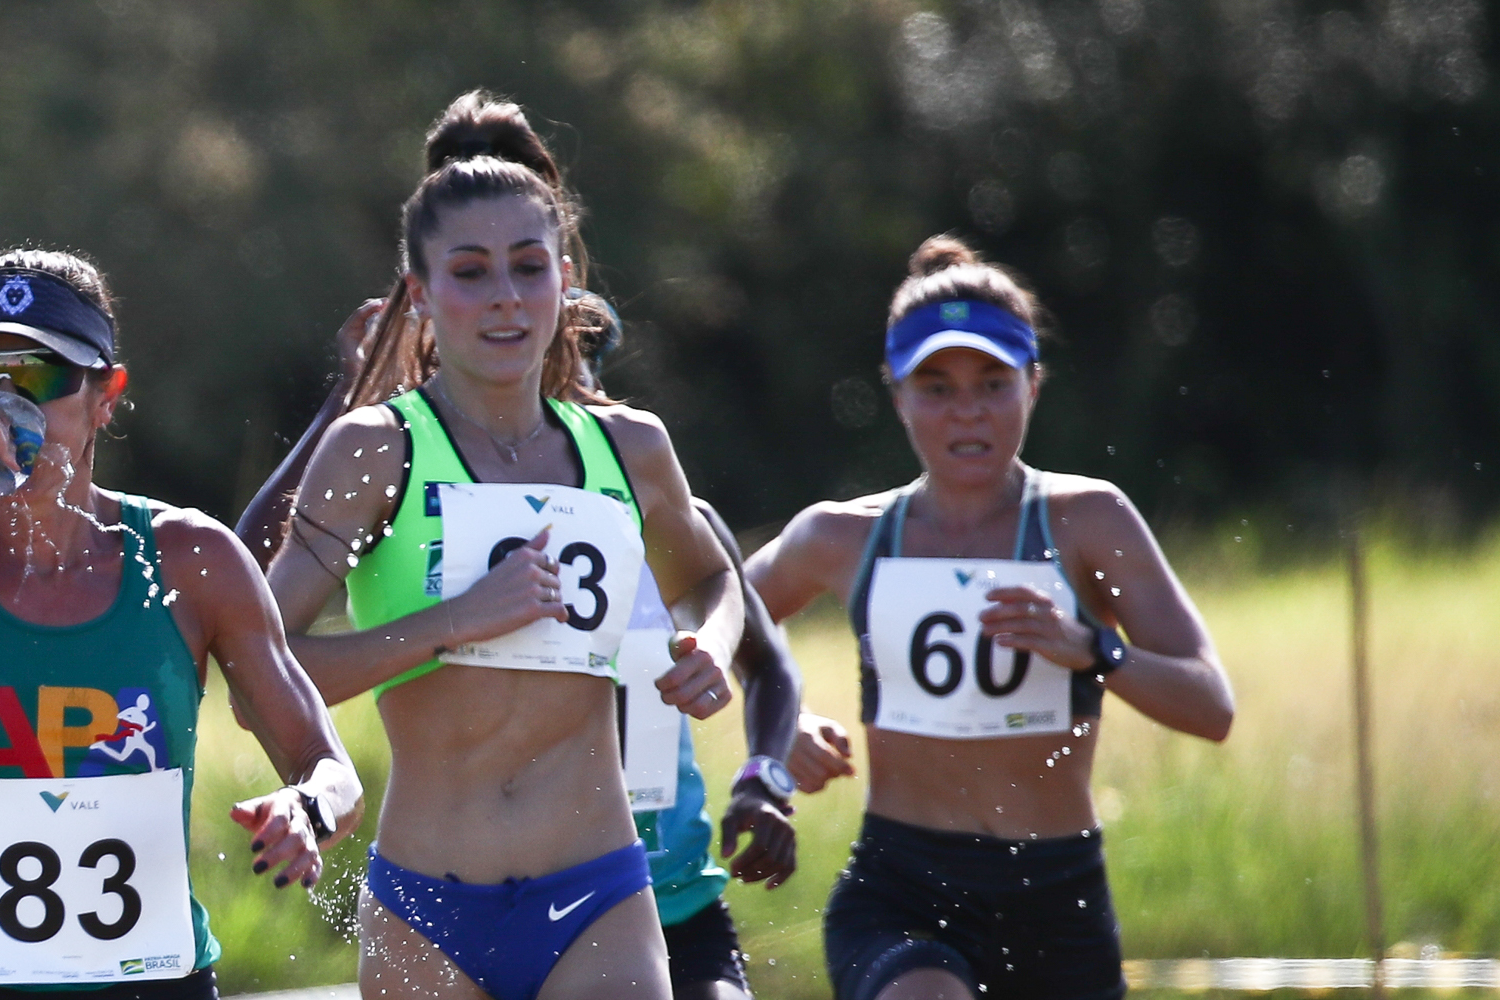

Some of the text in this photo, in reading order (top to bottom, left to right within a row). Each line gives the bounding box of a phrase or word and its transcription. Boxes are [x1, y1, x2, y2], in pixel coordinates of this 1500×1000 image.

[551, 505, 574, 515] VALE
[910, 610, 1031, 697] 60
[70, 799, 100, 810] VALE
[145, 958, 181, 969] BRASIL
